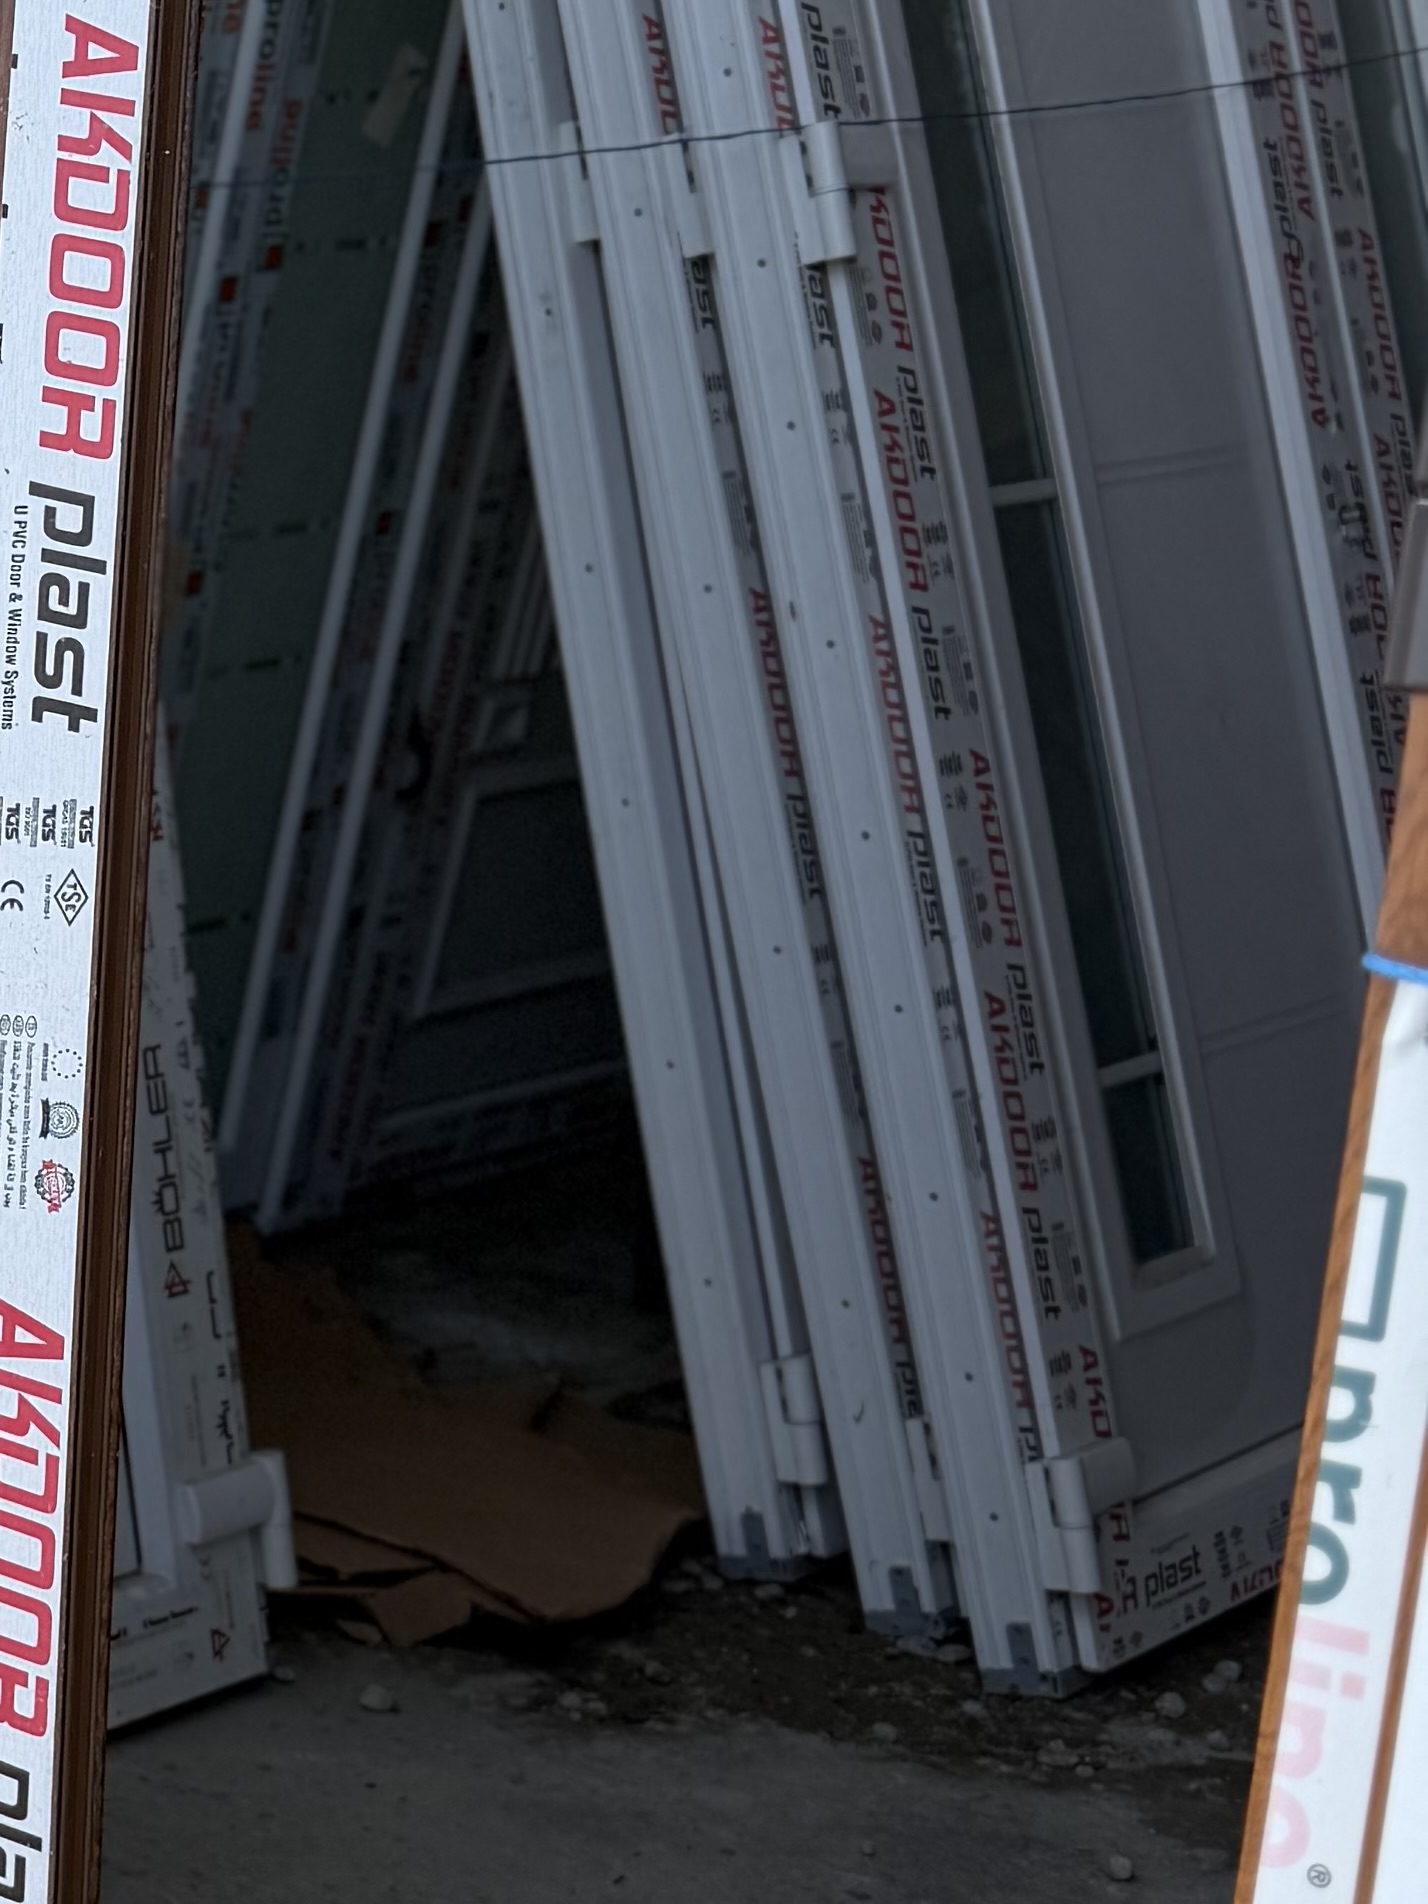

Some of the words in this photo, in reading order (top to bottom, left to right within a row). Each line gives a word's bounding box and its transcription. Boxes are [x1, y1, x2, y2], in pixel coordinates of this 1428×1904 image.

[801, 2, 842, 119] plast
[38, 13, 139, 459] AKDOOR
[870, 185, 914, 352] KDOOR
[897, 365, 937, 480] plast
[11, 520, 28, 549] PVC
[13, 505, 28, 514] U
[9, 554, 25, 588] Door
[874, 392, 927, 592] AKDOOR
[911, 606, 952, 720] plast
[8, 592, 23, 602] &
[28, 480, 107, 733] plast
[4, 608, 22, 665] Window
[1, 670, 19, 729] Systems
[0, 879, 24, 911] CE
[969, 751, 1023, 947] AKDOOR
[1006, 963, 1045, 1076] plast
[986, 994, 1038, 1193] AKDOOR
[1021, 1207, 1061, 1320] plast
[1144, 1545, 1203, 1609] plast
